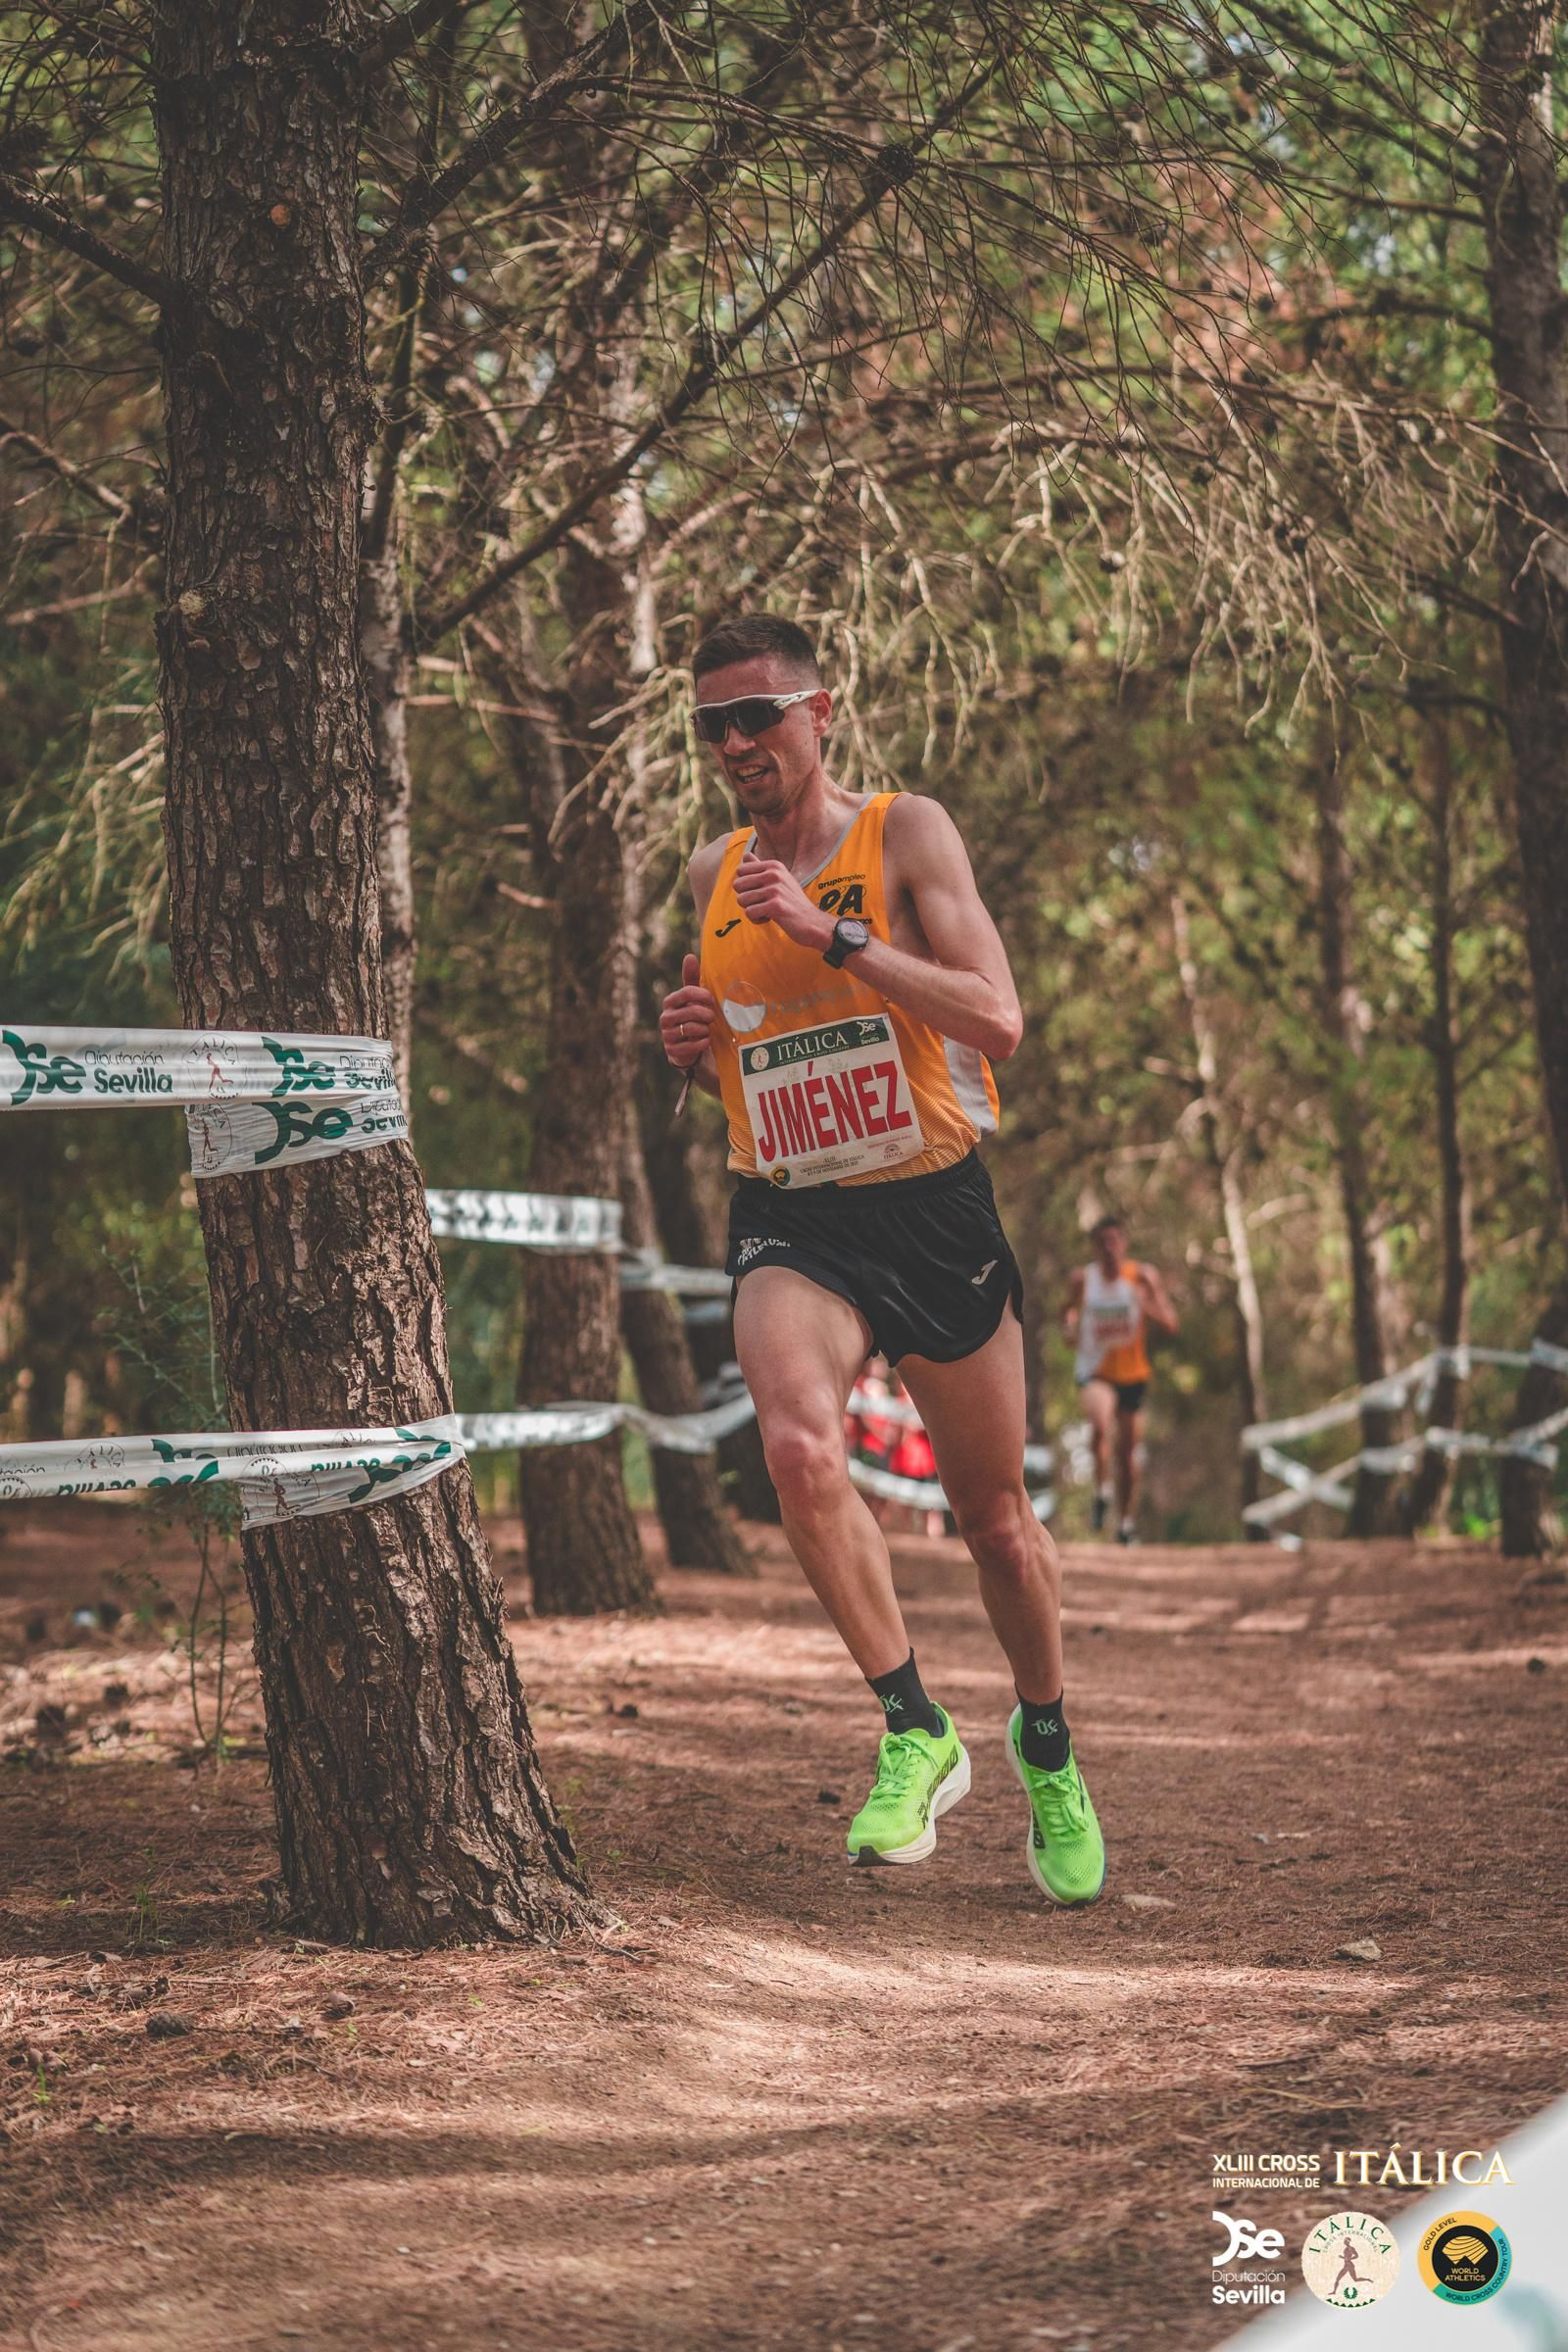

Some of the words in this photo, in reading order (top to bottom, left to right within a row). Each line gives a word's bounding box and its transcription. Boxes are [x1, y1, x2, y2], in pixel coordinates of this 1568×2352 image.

[777, 1031, 849, 1061] ITÁLICA
[94, 1067, 172, 1093] Sevilla
[759, 1061, 912, 1162] JIMÉNEZ
